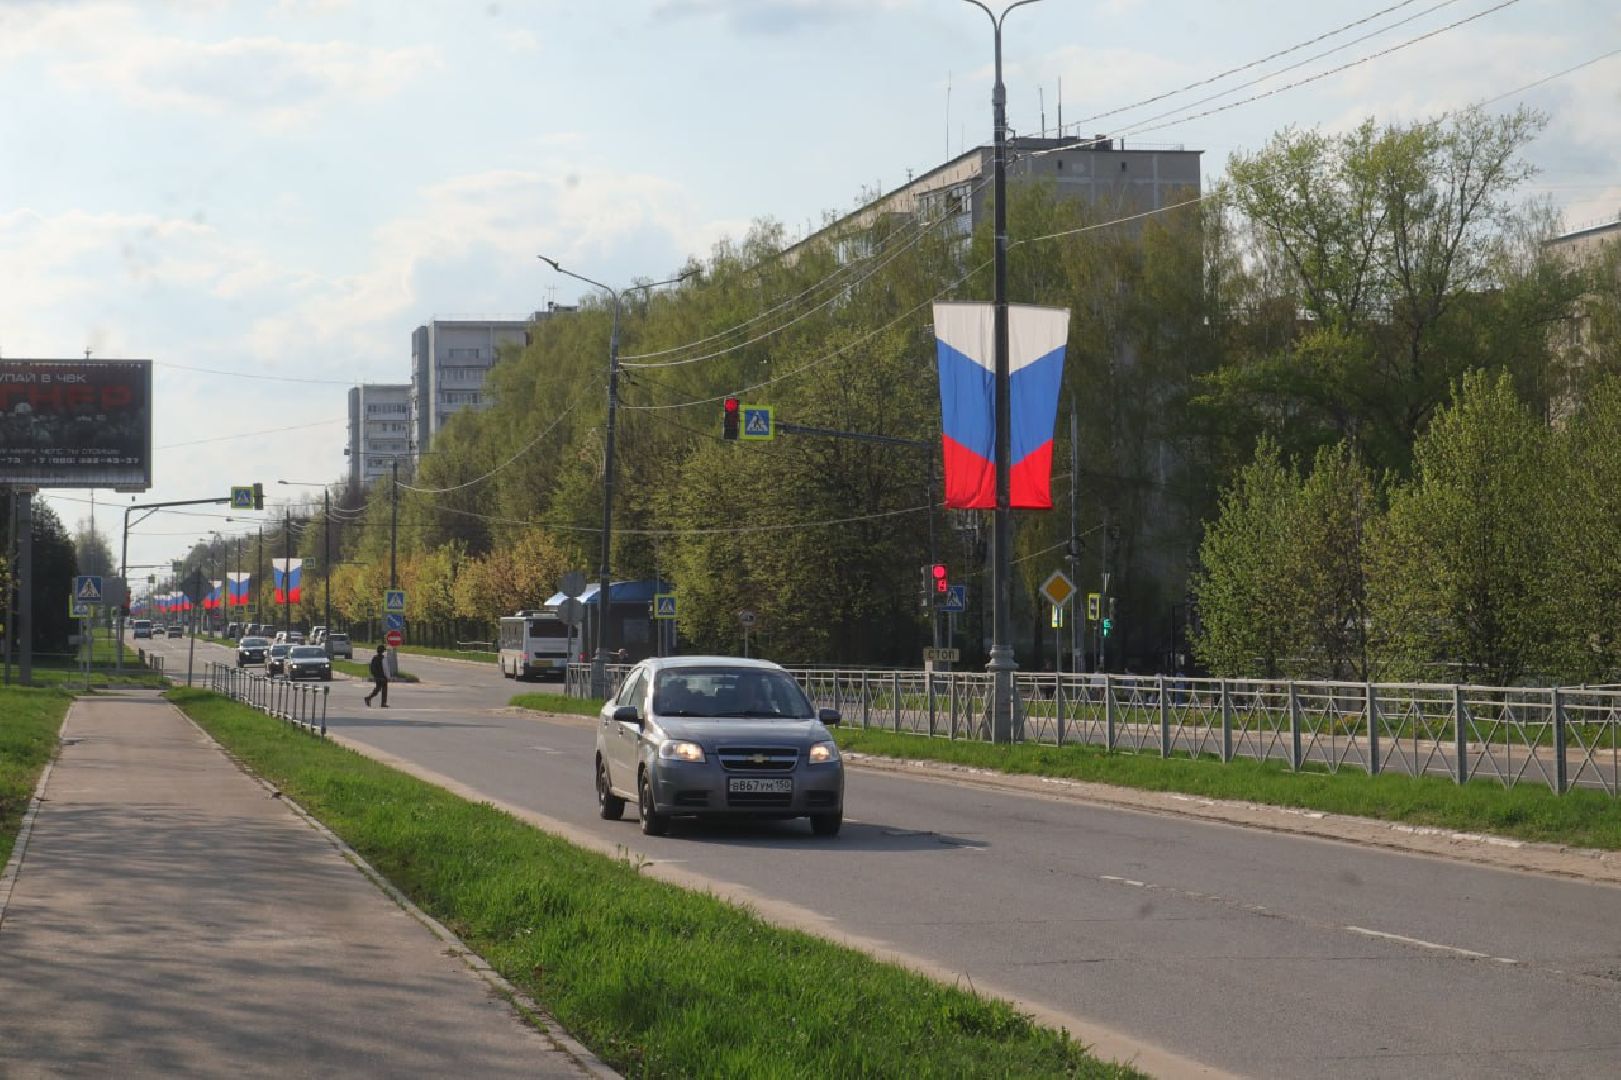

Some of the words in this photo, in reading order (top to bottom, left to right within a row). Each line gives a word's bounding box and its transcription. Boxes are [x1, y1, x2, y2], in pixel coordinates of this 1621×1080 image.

[41, 373, 51, 383] В
[56, 373, 88, 383] ЧВК
[928, 649, 955, 660] СТОП
